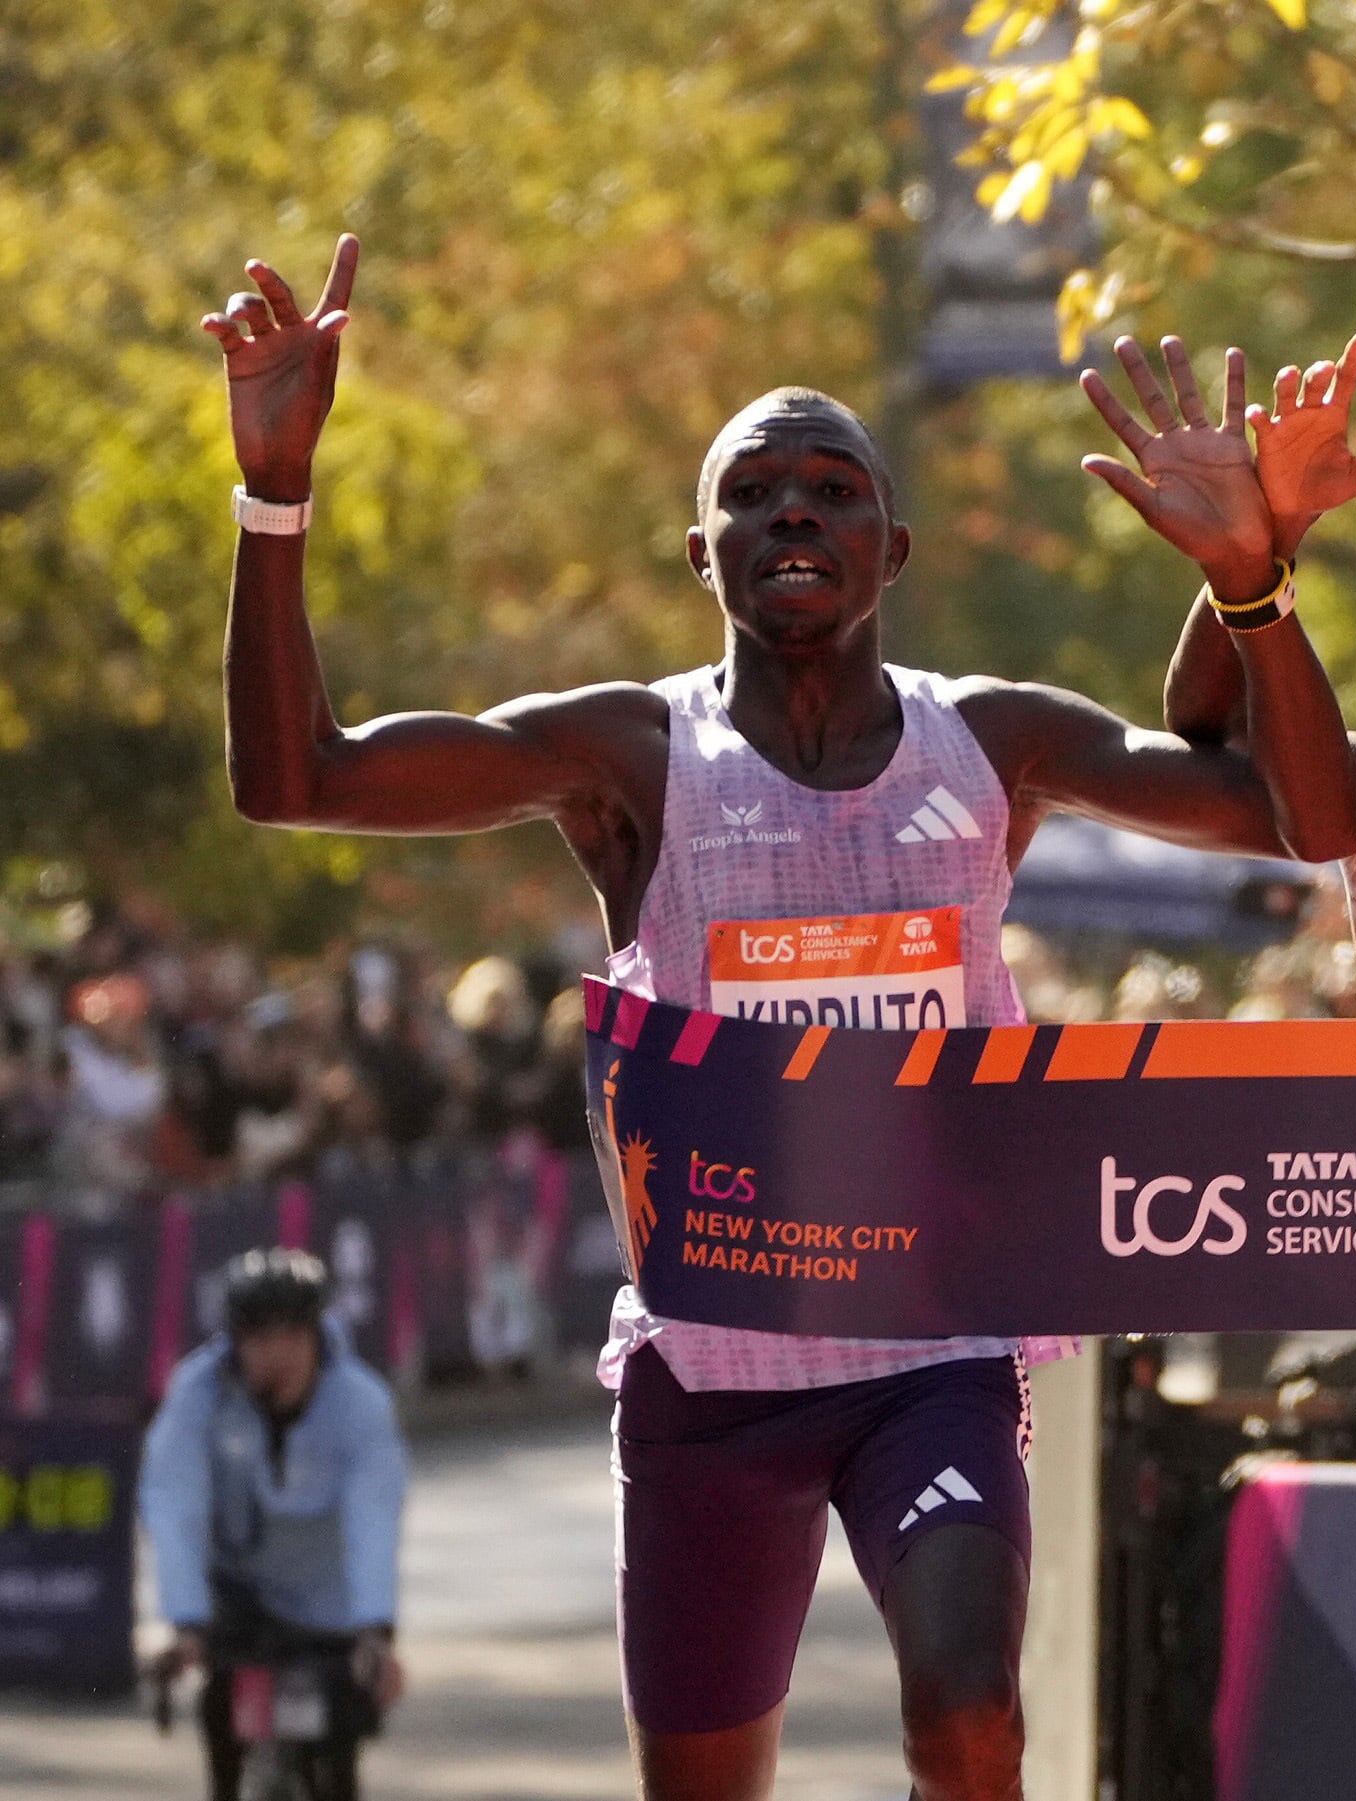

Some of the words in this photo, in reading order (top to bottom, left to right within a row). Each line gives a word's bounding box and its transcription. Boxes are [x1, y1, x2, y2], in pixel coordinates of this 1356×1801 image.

[690, 831, 743, 852] Tirop's
[746, 828, 801, 844] Angels
[801, 925, 833, 936] TATA
[801, 934, 878, 949] CONSULTANCY
[740, 929, 795, 964] tcs
[801, 949, 851, 962] SERVICES
[900, 941, 937, 956] TATA
[689, 1150, 756, 1202] tcs
[1101, 1155, 1247, 1257] tcs
[685, 1209, 754, 1240] NEW
[762, 1220, 845, 1249] YORK
[852, 1226, 918, 1251] CITY
[682, 1241, 857, 1281] MARATHON
